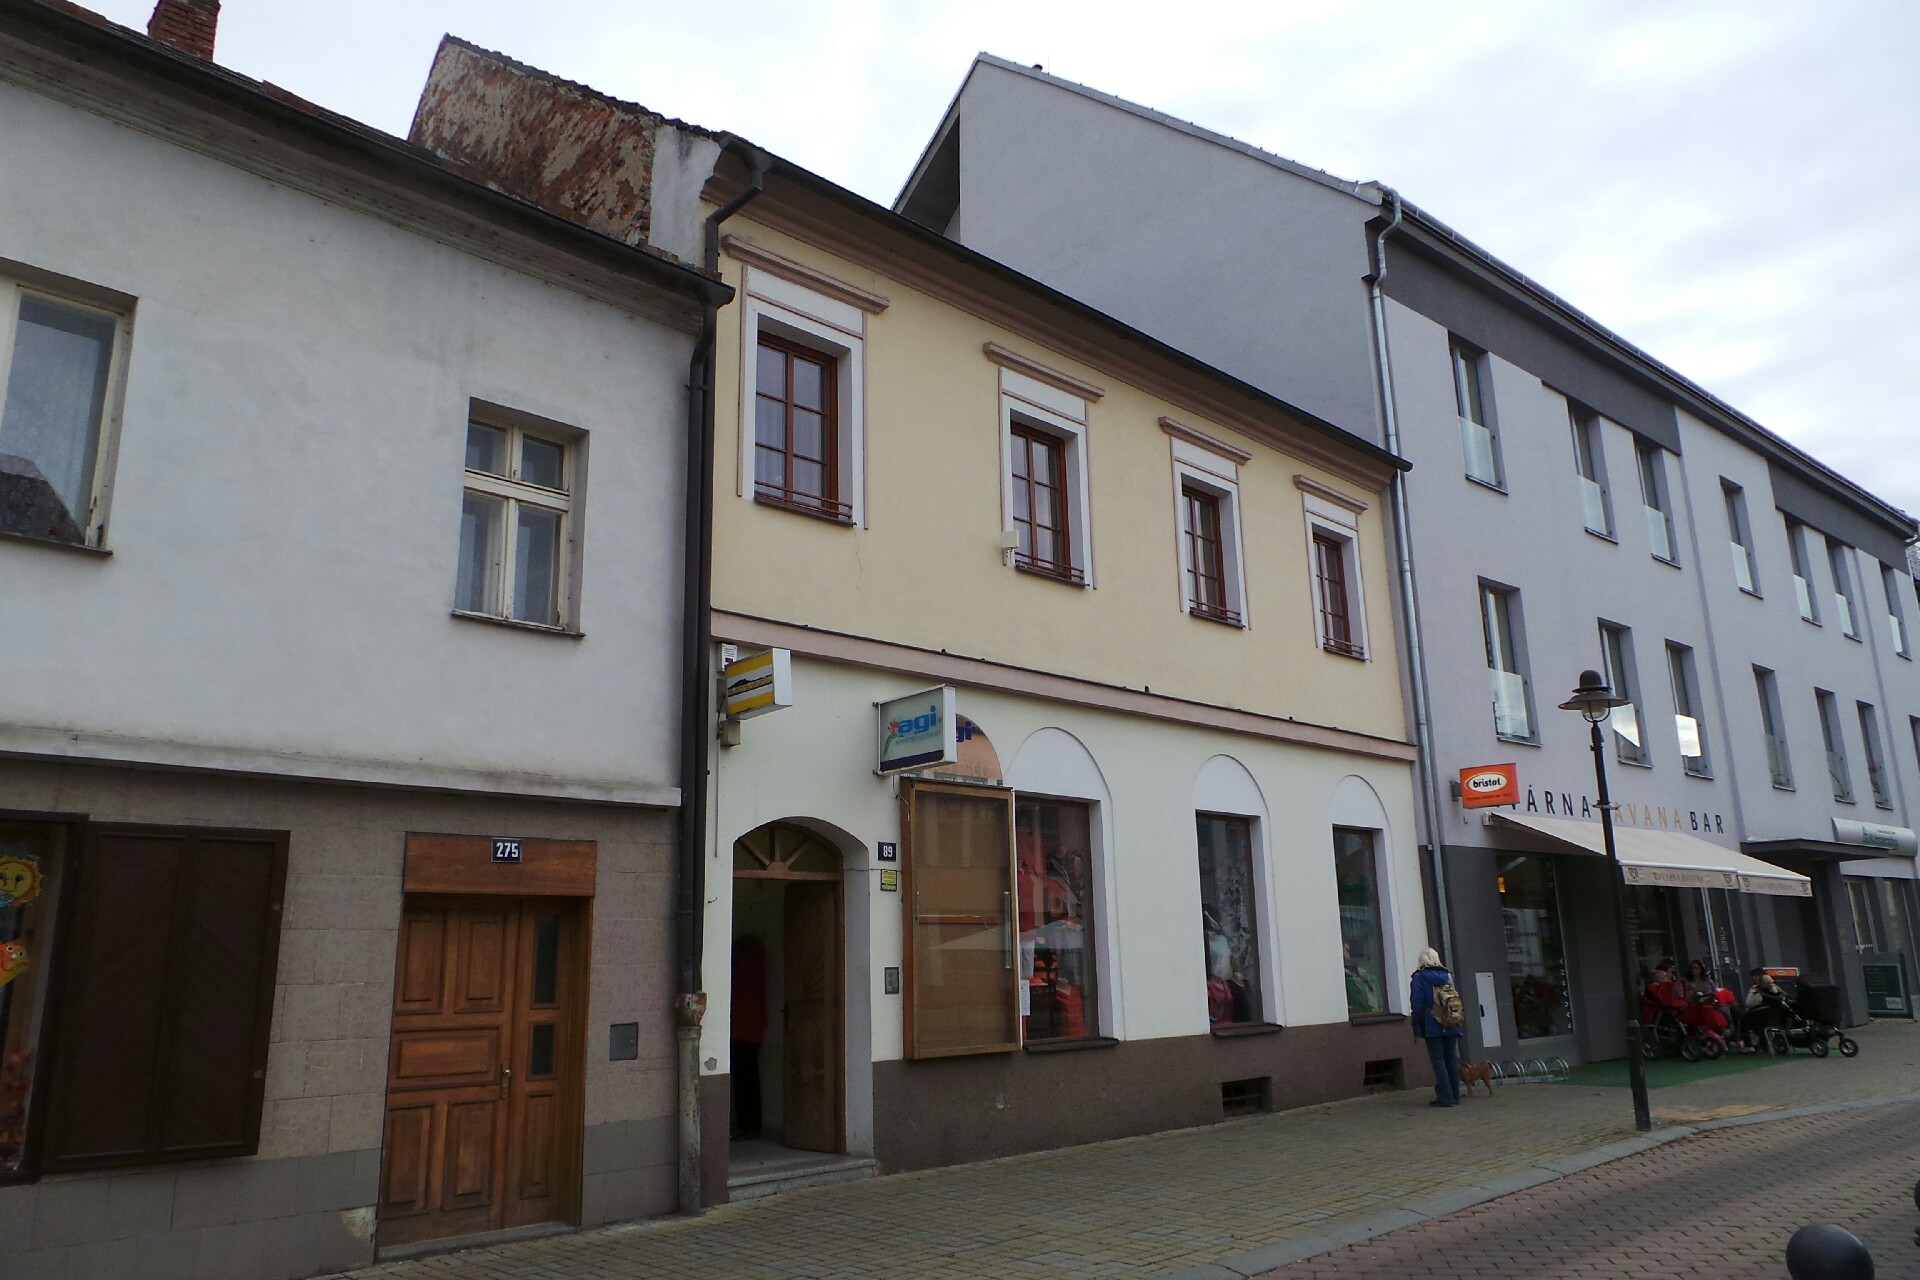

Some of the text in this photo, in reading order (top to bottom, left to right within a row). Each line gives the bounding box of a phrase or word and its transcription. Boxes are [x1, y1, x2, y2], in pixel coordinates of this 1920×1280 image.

[1614, 802, 1683, 830] AVANA
[1689, 811, 1725, 835] BAR
[495, 842, 519, 858] 275
[883, 845, 893, 858] 89
